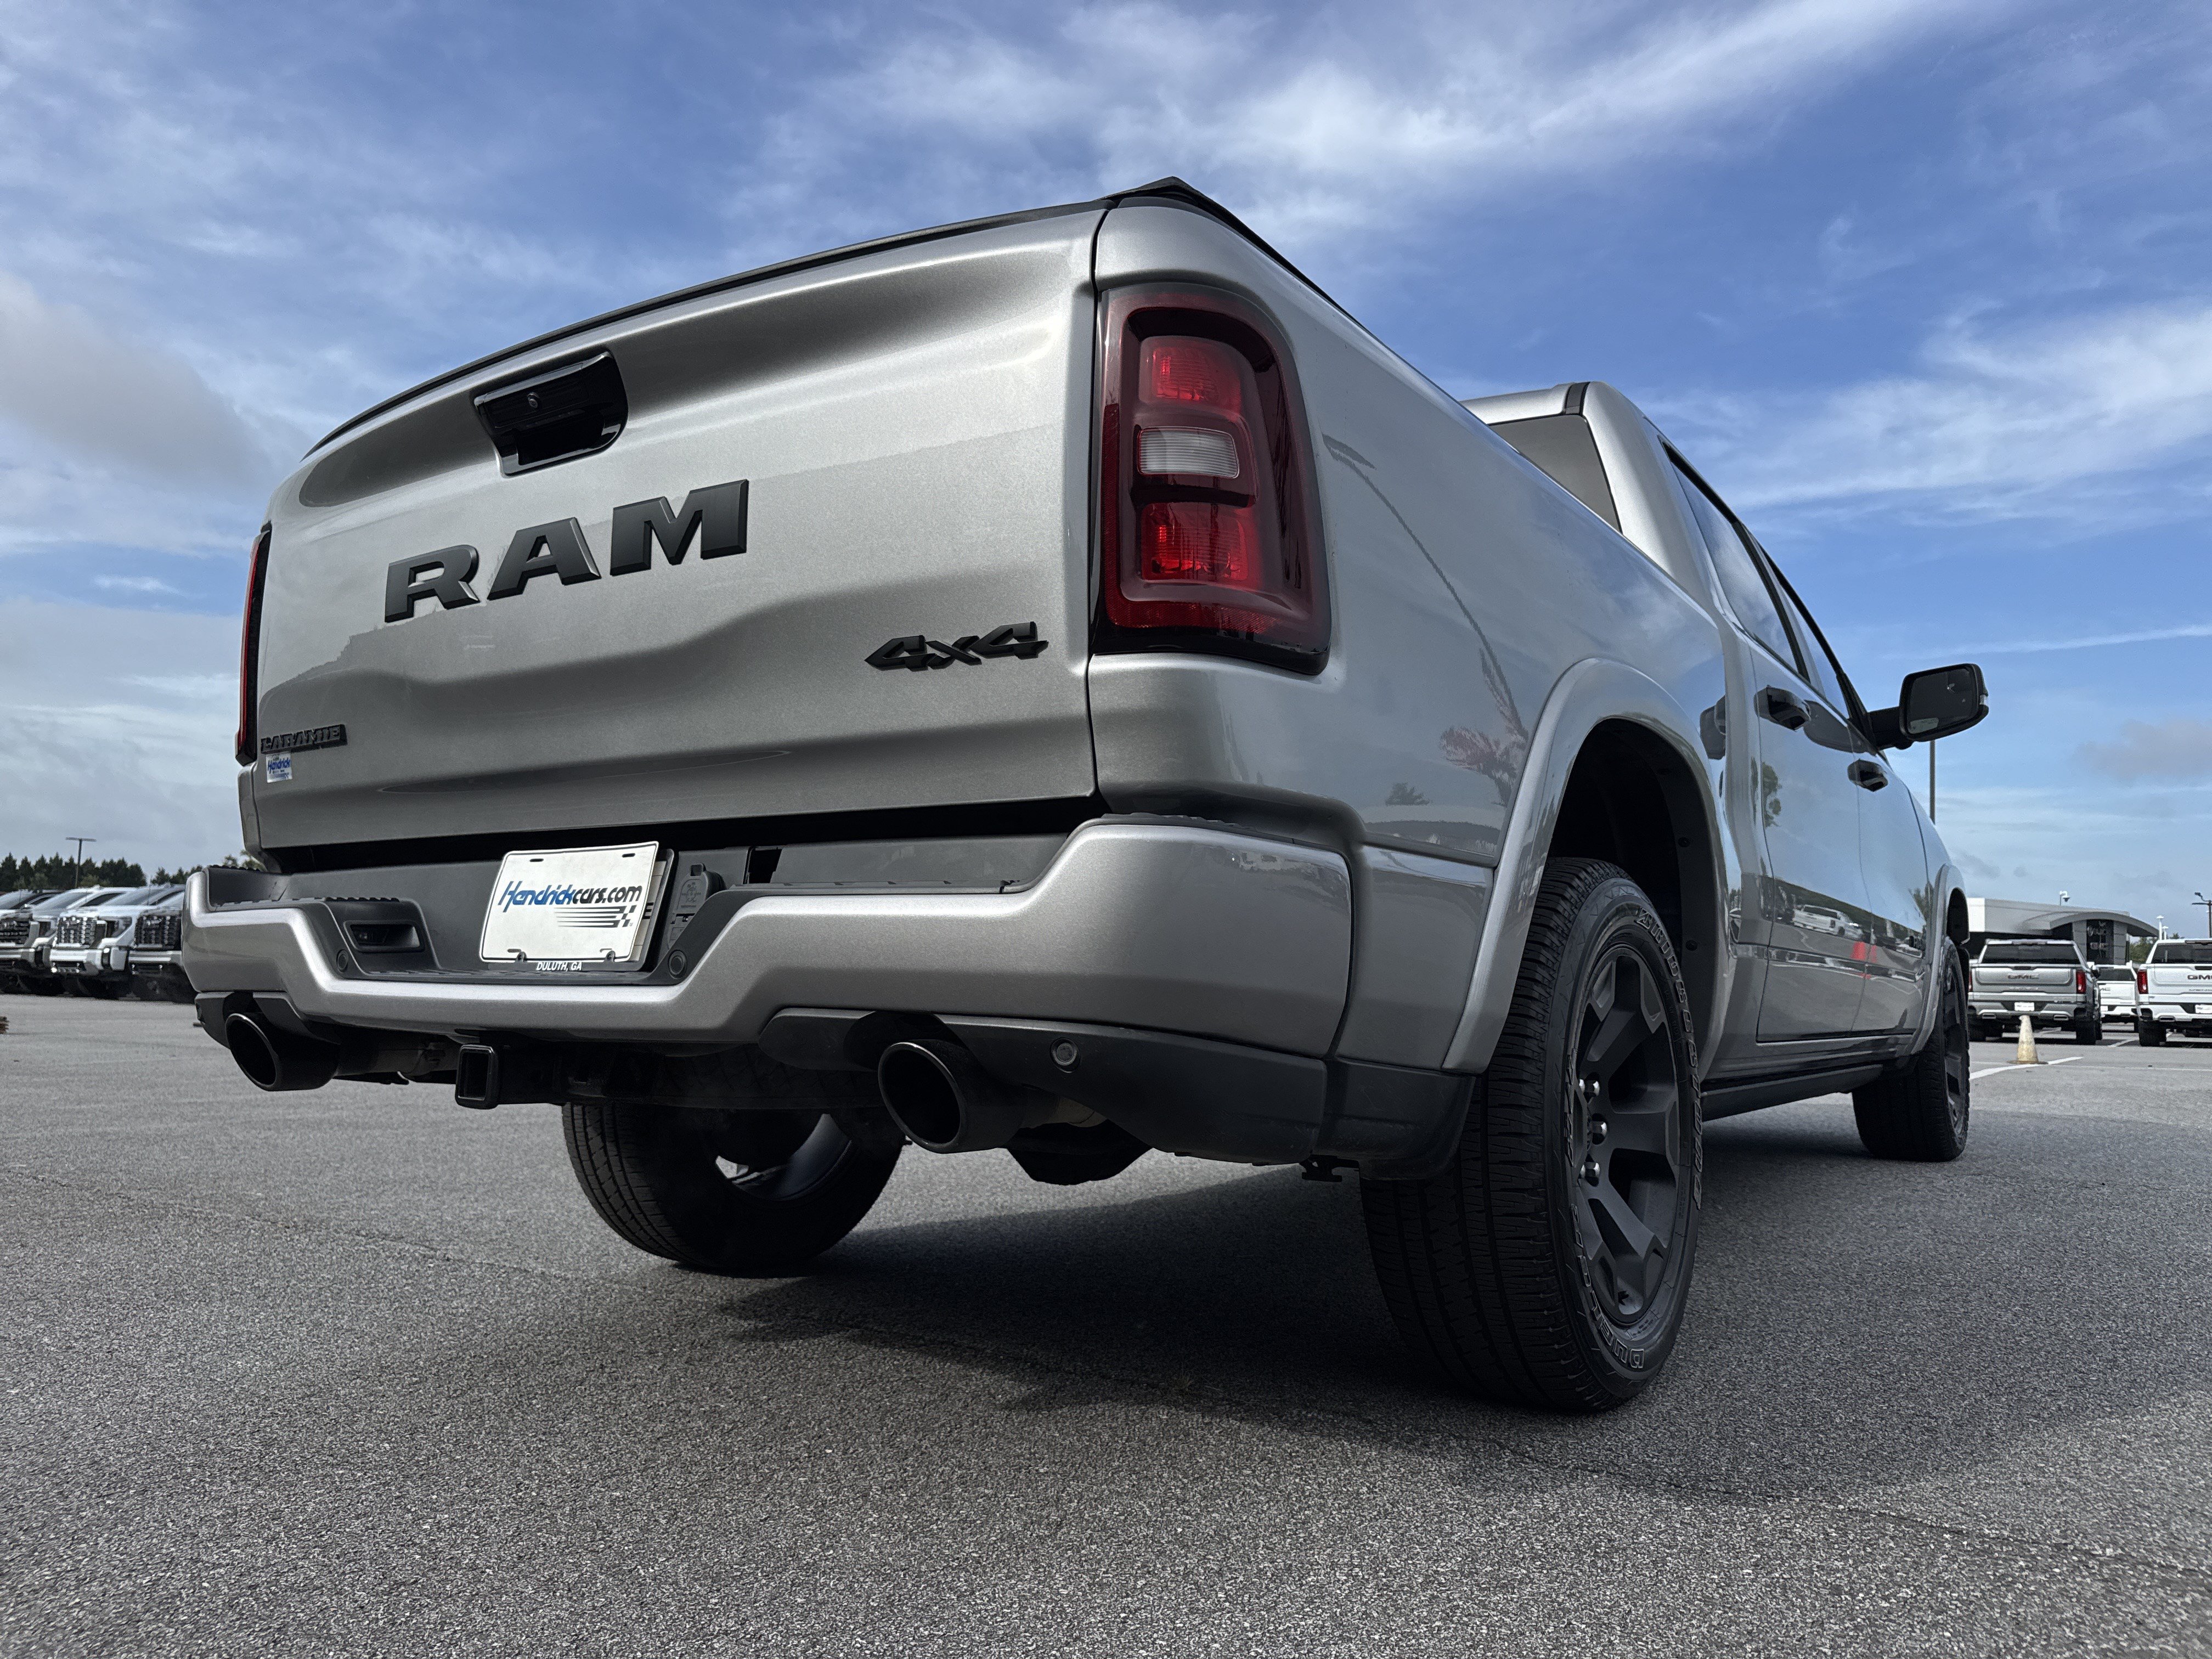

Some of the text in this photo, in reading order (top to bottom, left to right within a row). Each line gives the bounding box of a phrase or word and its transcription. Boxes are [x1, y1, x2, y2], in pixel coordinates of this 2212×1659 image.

[384, 478, 749, 624] RAM
[498, 881, 643, 913] Hendrickcars.com
[535, 961, 583, 972] DULUTH, GA
